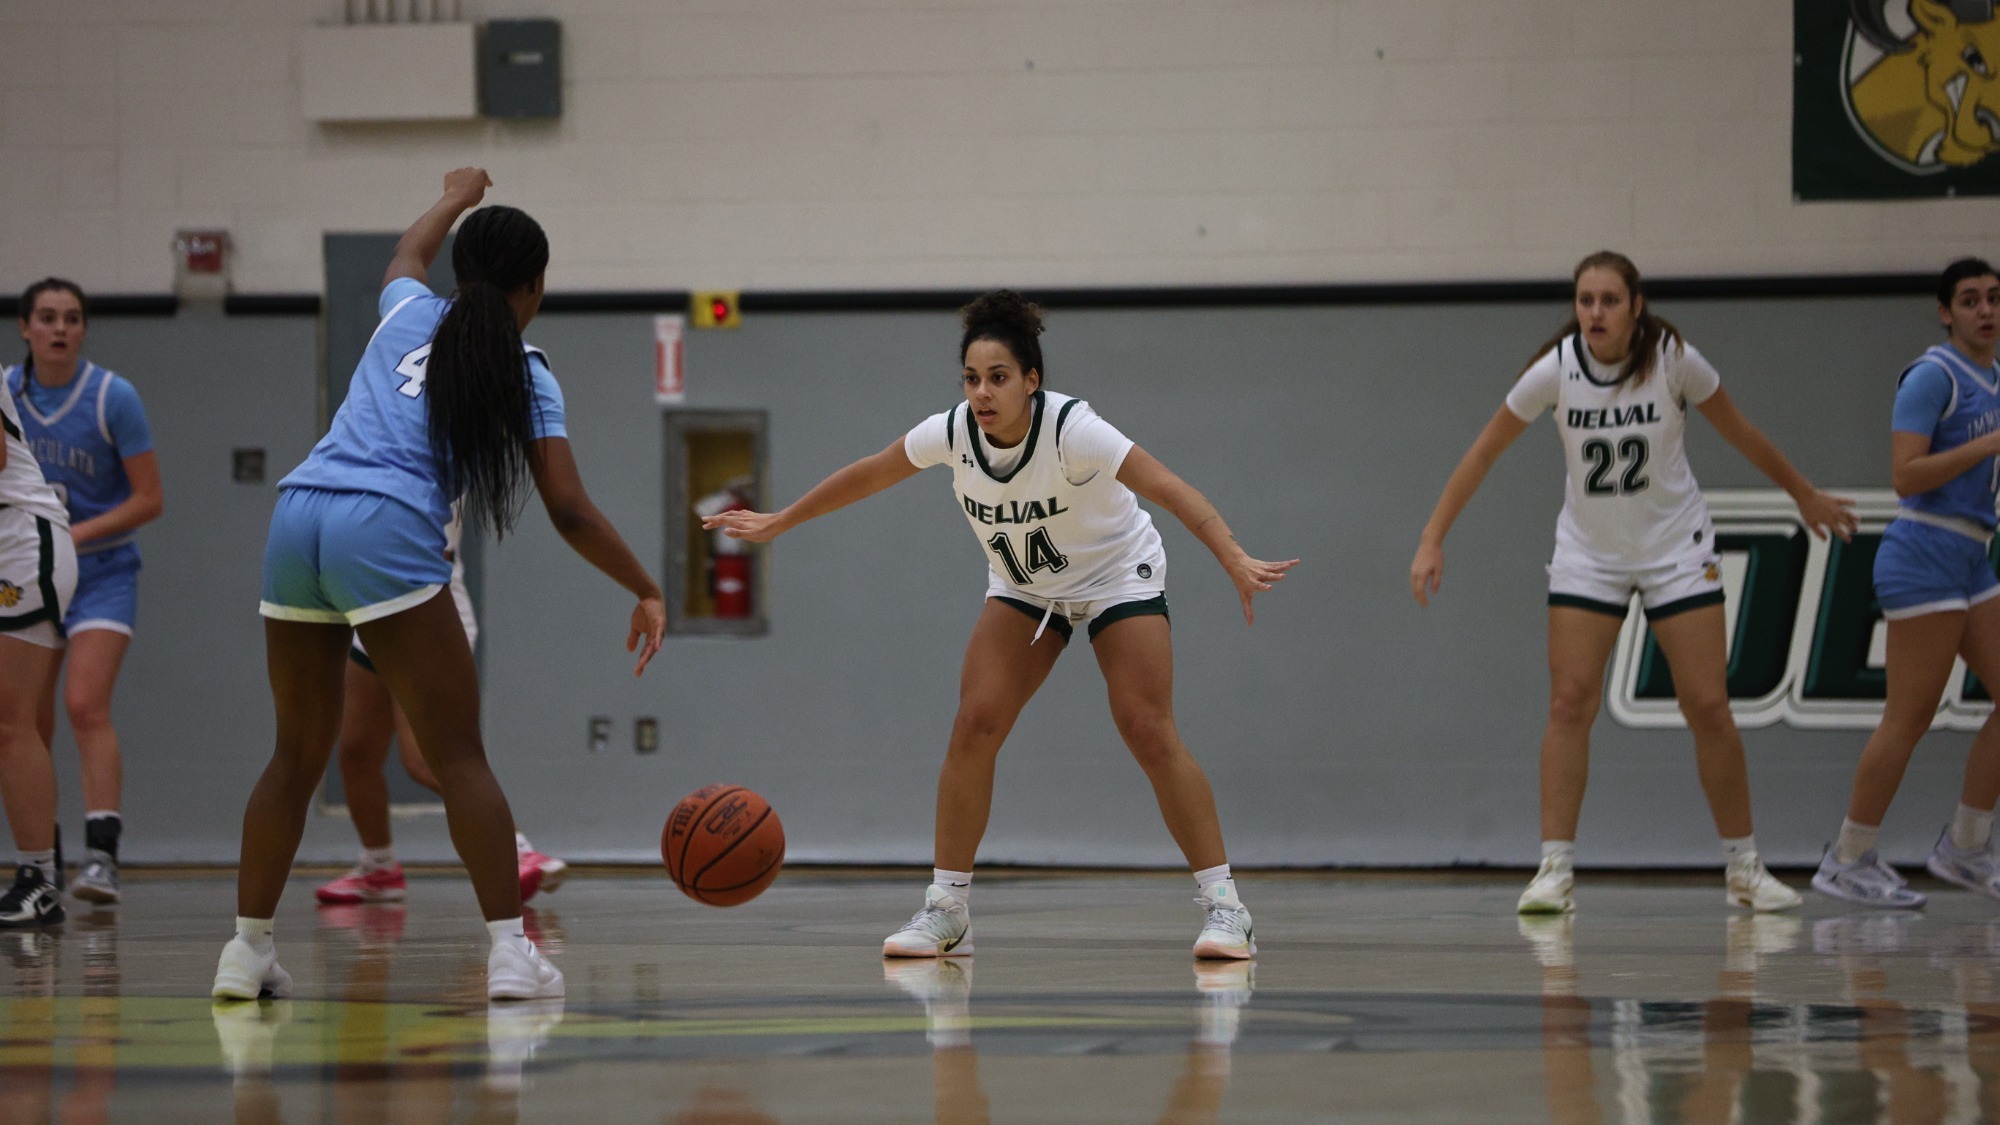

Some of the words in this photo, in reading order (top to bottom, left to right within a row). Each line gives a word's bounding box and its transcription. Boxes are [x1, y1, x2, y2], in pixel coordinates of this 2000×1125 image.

[392, 341, 433, 400] 4
[1567, 402, 1661, 429] DELVAL
[1582, 432, 1649, 497] 22
[962, 493, 1069, 525] DELVAL
[986, 525, 1069, 586] 14
[672, 804, 697, 837] THE
